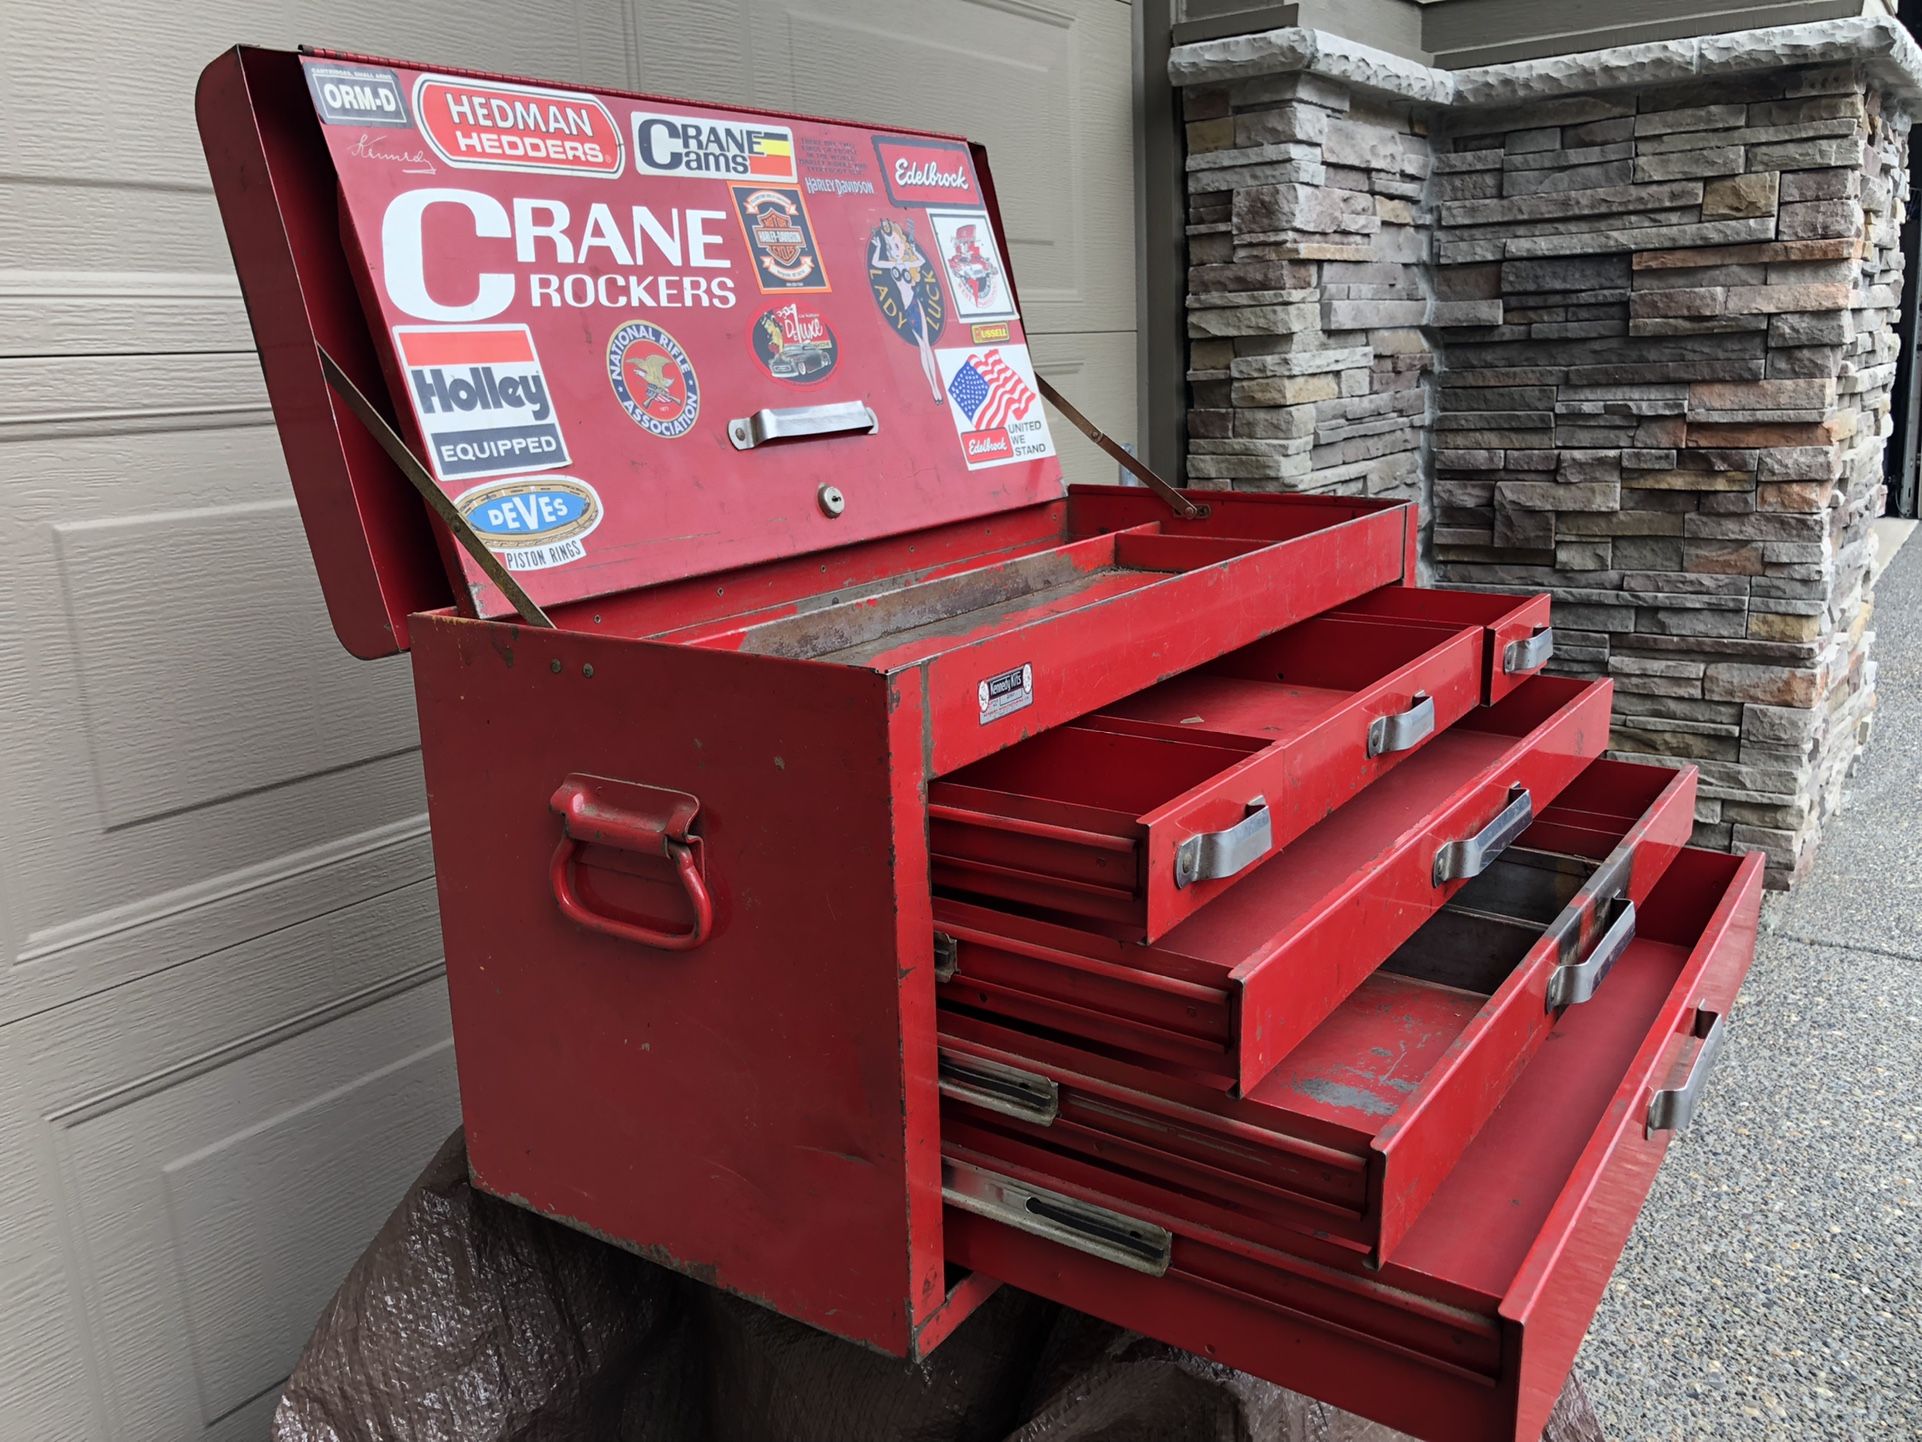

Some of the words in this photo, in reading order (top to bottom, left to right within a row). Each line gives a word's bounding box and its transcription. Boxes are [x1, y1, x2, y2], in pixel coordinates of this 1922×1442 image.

[324, 83, 396, 112] ORM-D
[445, 92, 594, 138] HEDMAN
[455, 130, 604, 163] HEDDERS
[638, 118, 765, 170] CRANE
[895, 158, 969, 190] Edelbrock
[382, 188, 732, 322] CRANE
[529, 274, 736, 309] ROCKERS
[870, 269, 907, 329] LADY
[922, 270, 942, 330] LUCK
[610, 325, 655, 380] NATIONAL
[659, 334, 690, 373] RIFLE
[411, 366, 552, 421] Holley
[623, 392, 698, 436] ASSOCIATION
[1008, 421, 1041, 434] UNITED
[440, 434, 557, 463] EQUIPPED
[969, 438, 1007, 456] Edelbrock
[1011, 435, 1026, 445] WE
[1015, 443, 1046, 456] STAND
[506, 550, 546, 569] PISTON
[549, 540, 581, 563] RINGS
